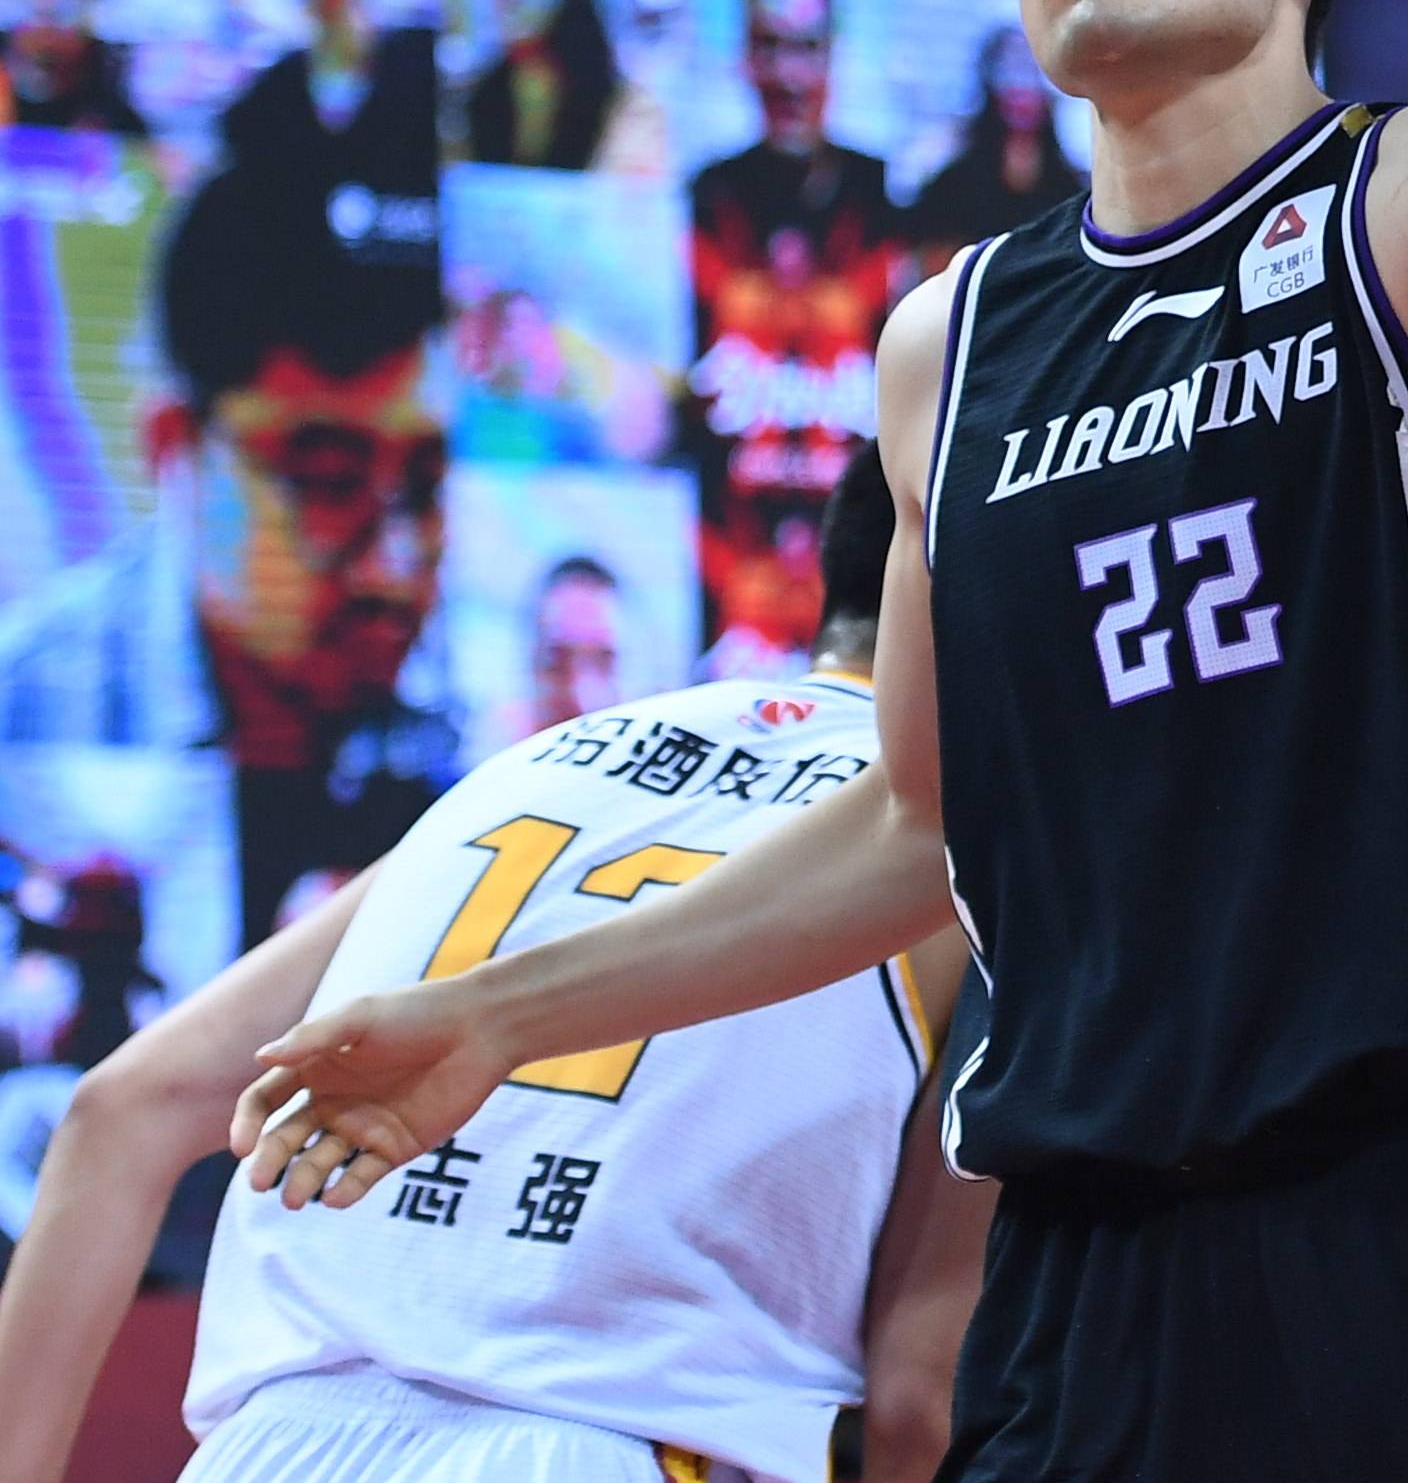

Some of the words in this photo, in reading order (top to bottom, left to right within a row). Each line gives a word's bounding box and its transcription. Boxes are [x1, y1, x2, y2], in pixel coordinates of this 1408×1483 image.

[1252, 246, 1315, 284] 广发银行
[1267, 270, 1306, 299] CGB
[986, 322, 1338, 503] LIAONING
[1075, 498, 1283, 708] 22
